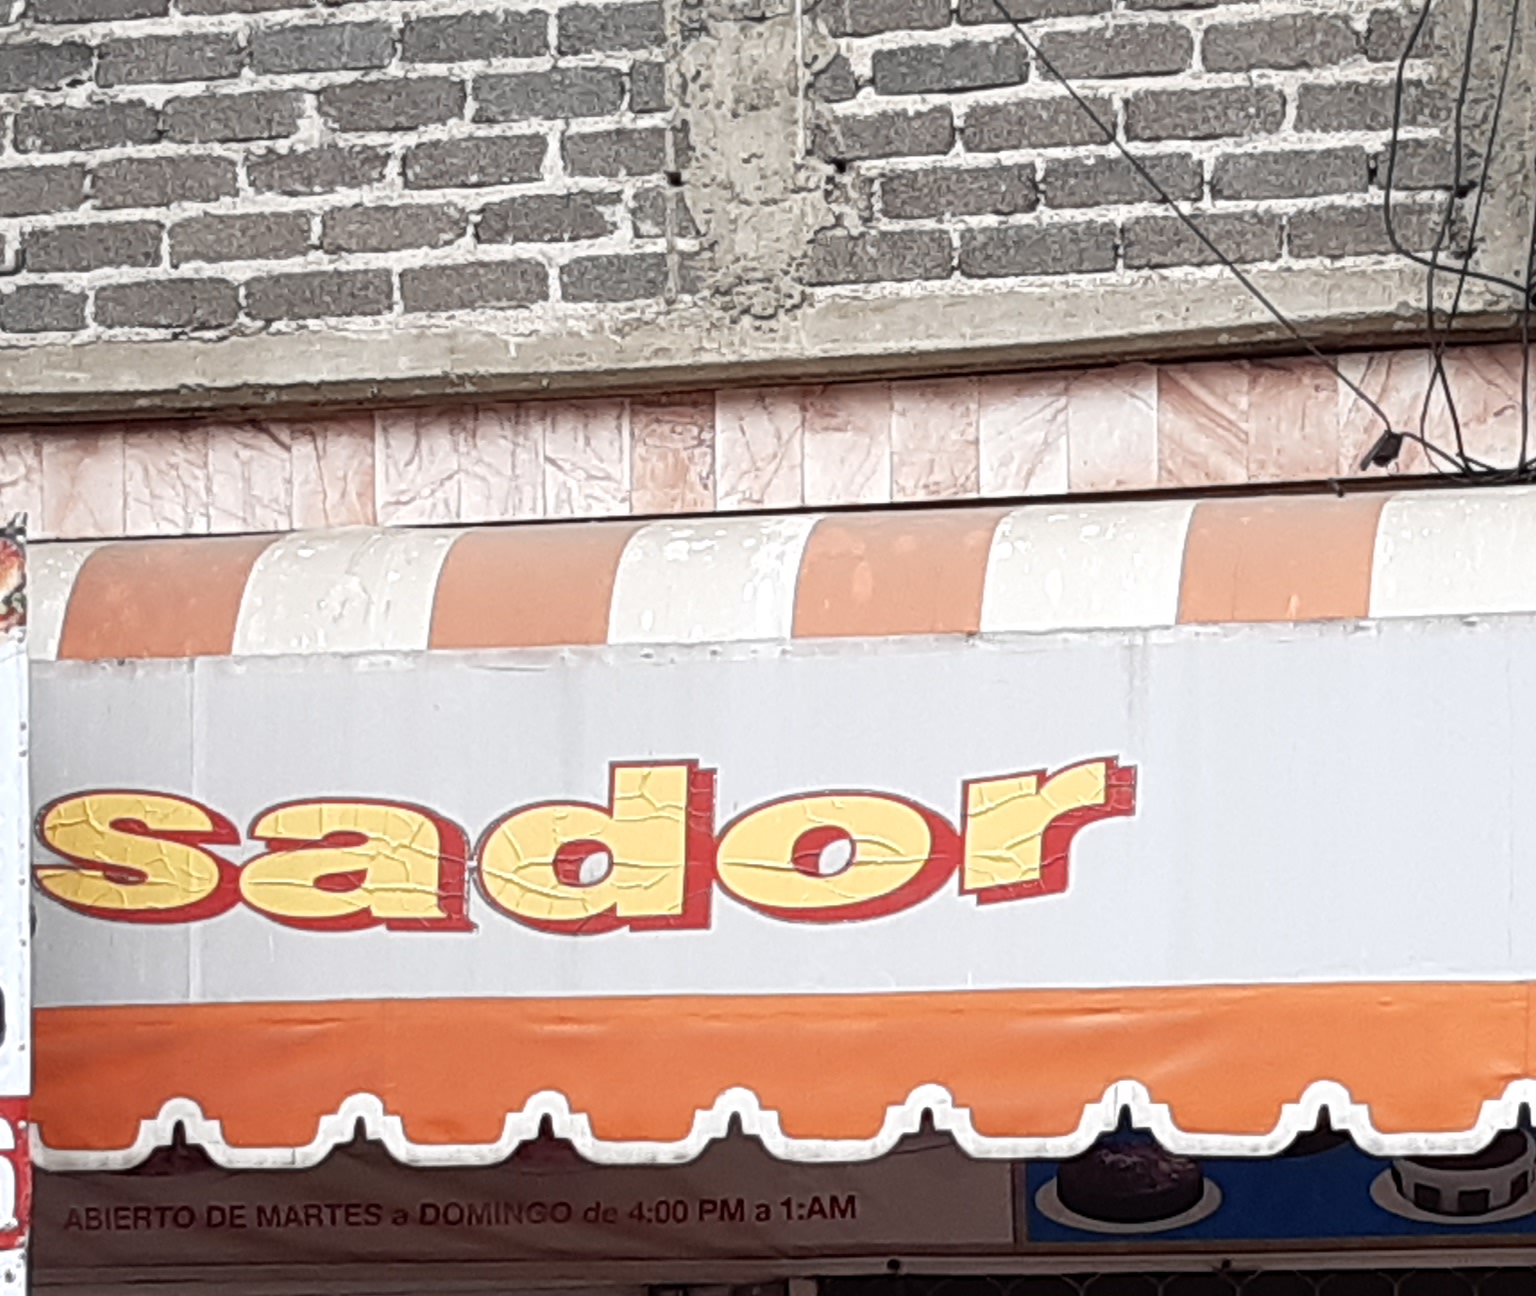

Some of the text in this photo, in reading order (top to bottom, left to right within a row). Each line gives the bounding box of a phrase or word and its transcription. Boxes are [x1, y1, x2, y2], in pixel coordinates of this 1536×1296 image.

[31, 757, 1136, 934] sador
[64, 1195, 856, 1231] ABIERTO DE MARTES a DOMINGO de 4:00 PM a 1:AM
